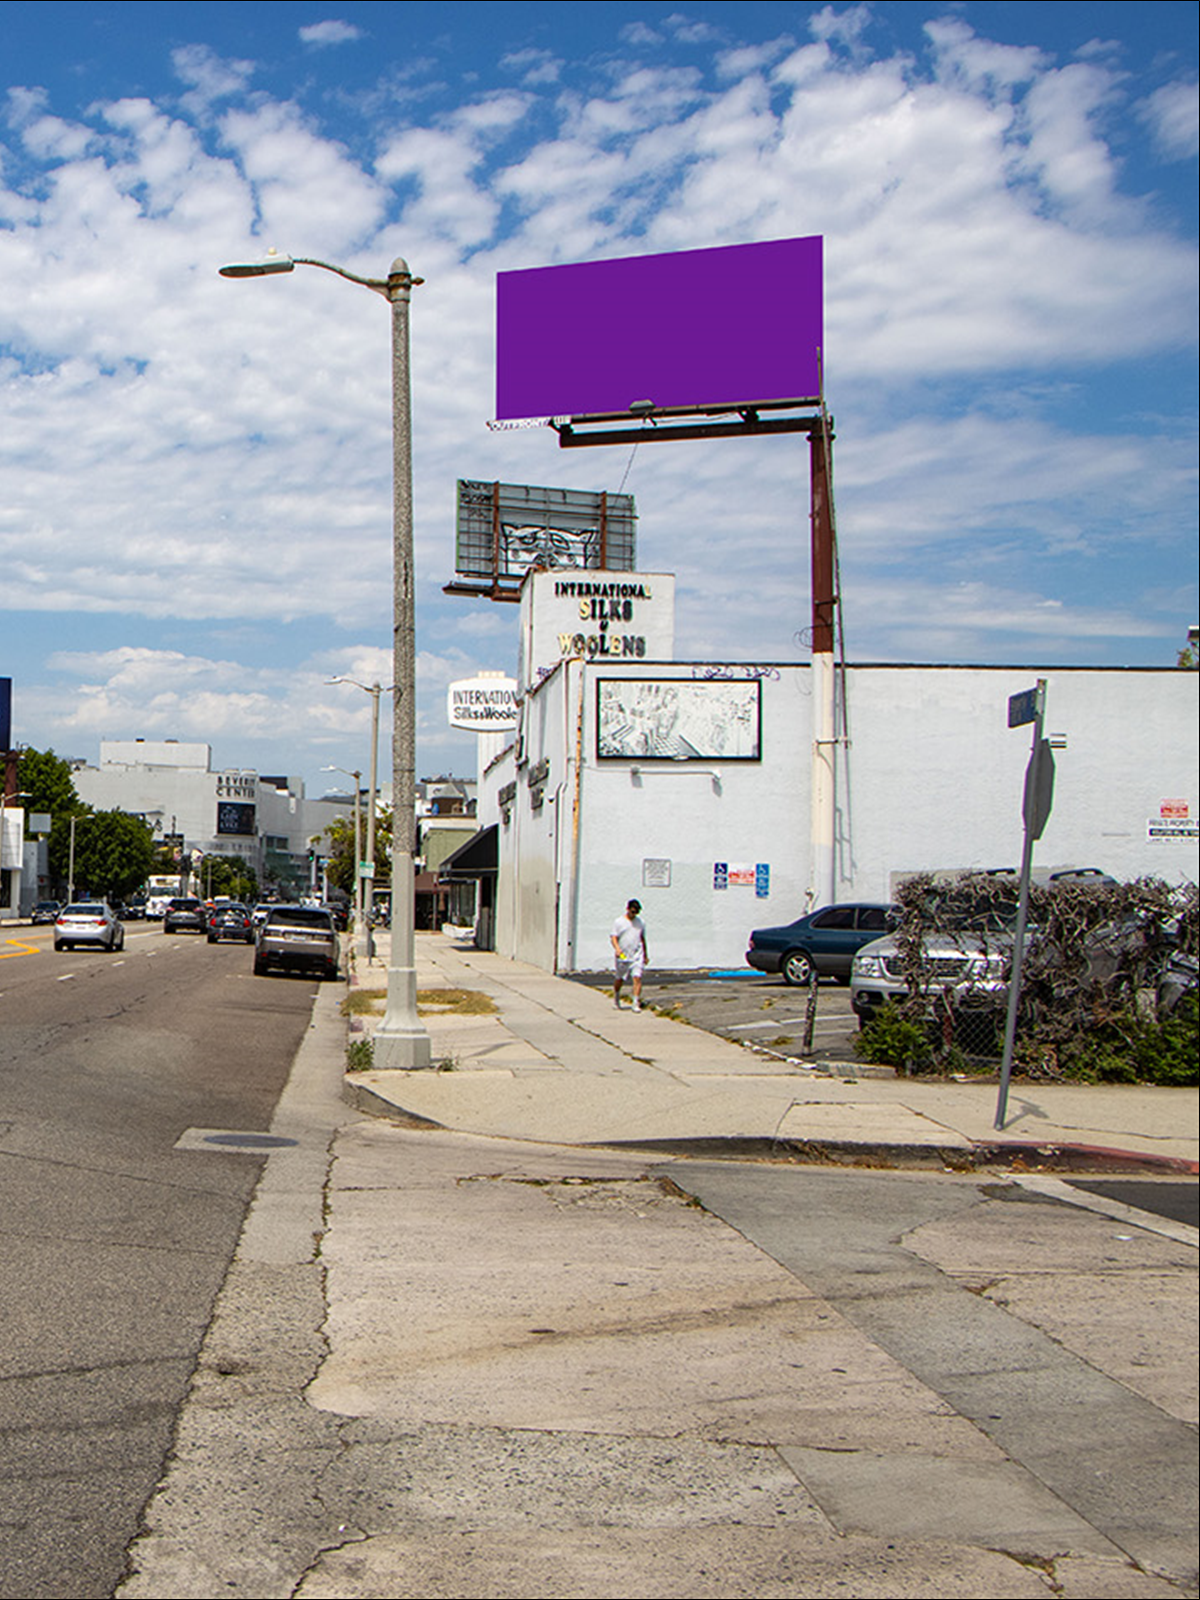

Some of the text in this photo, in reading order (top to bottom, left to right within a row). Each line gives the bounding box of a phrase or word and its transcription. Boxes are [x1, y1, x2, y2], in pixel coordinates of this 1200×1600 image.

[554, 582, 652, 598] INTERNATIONAL
[579, 598, 633, 621] SILKS
[557, 633, 646, 657] WOOLENS
